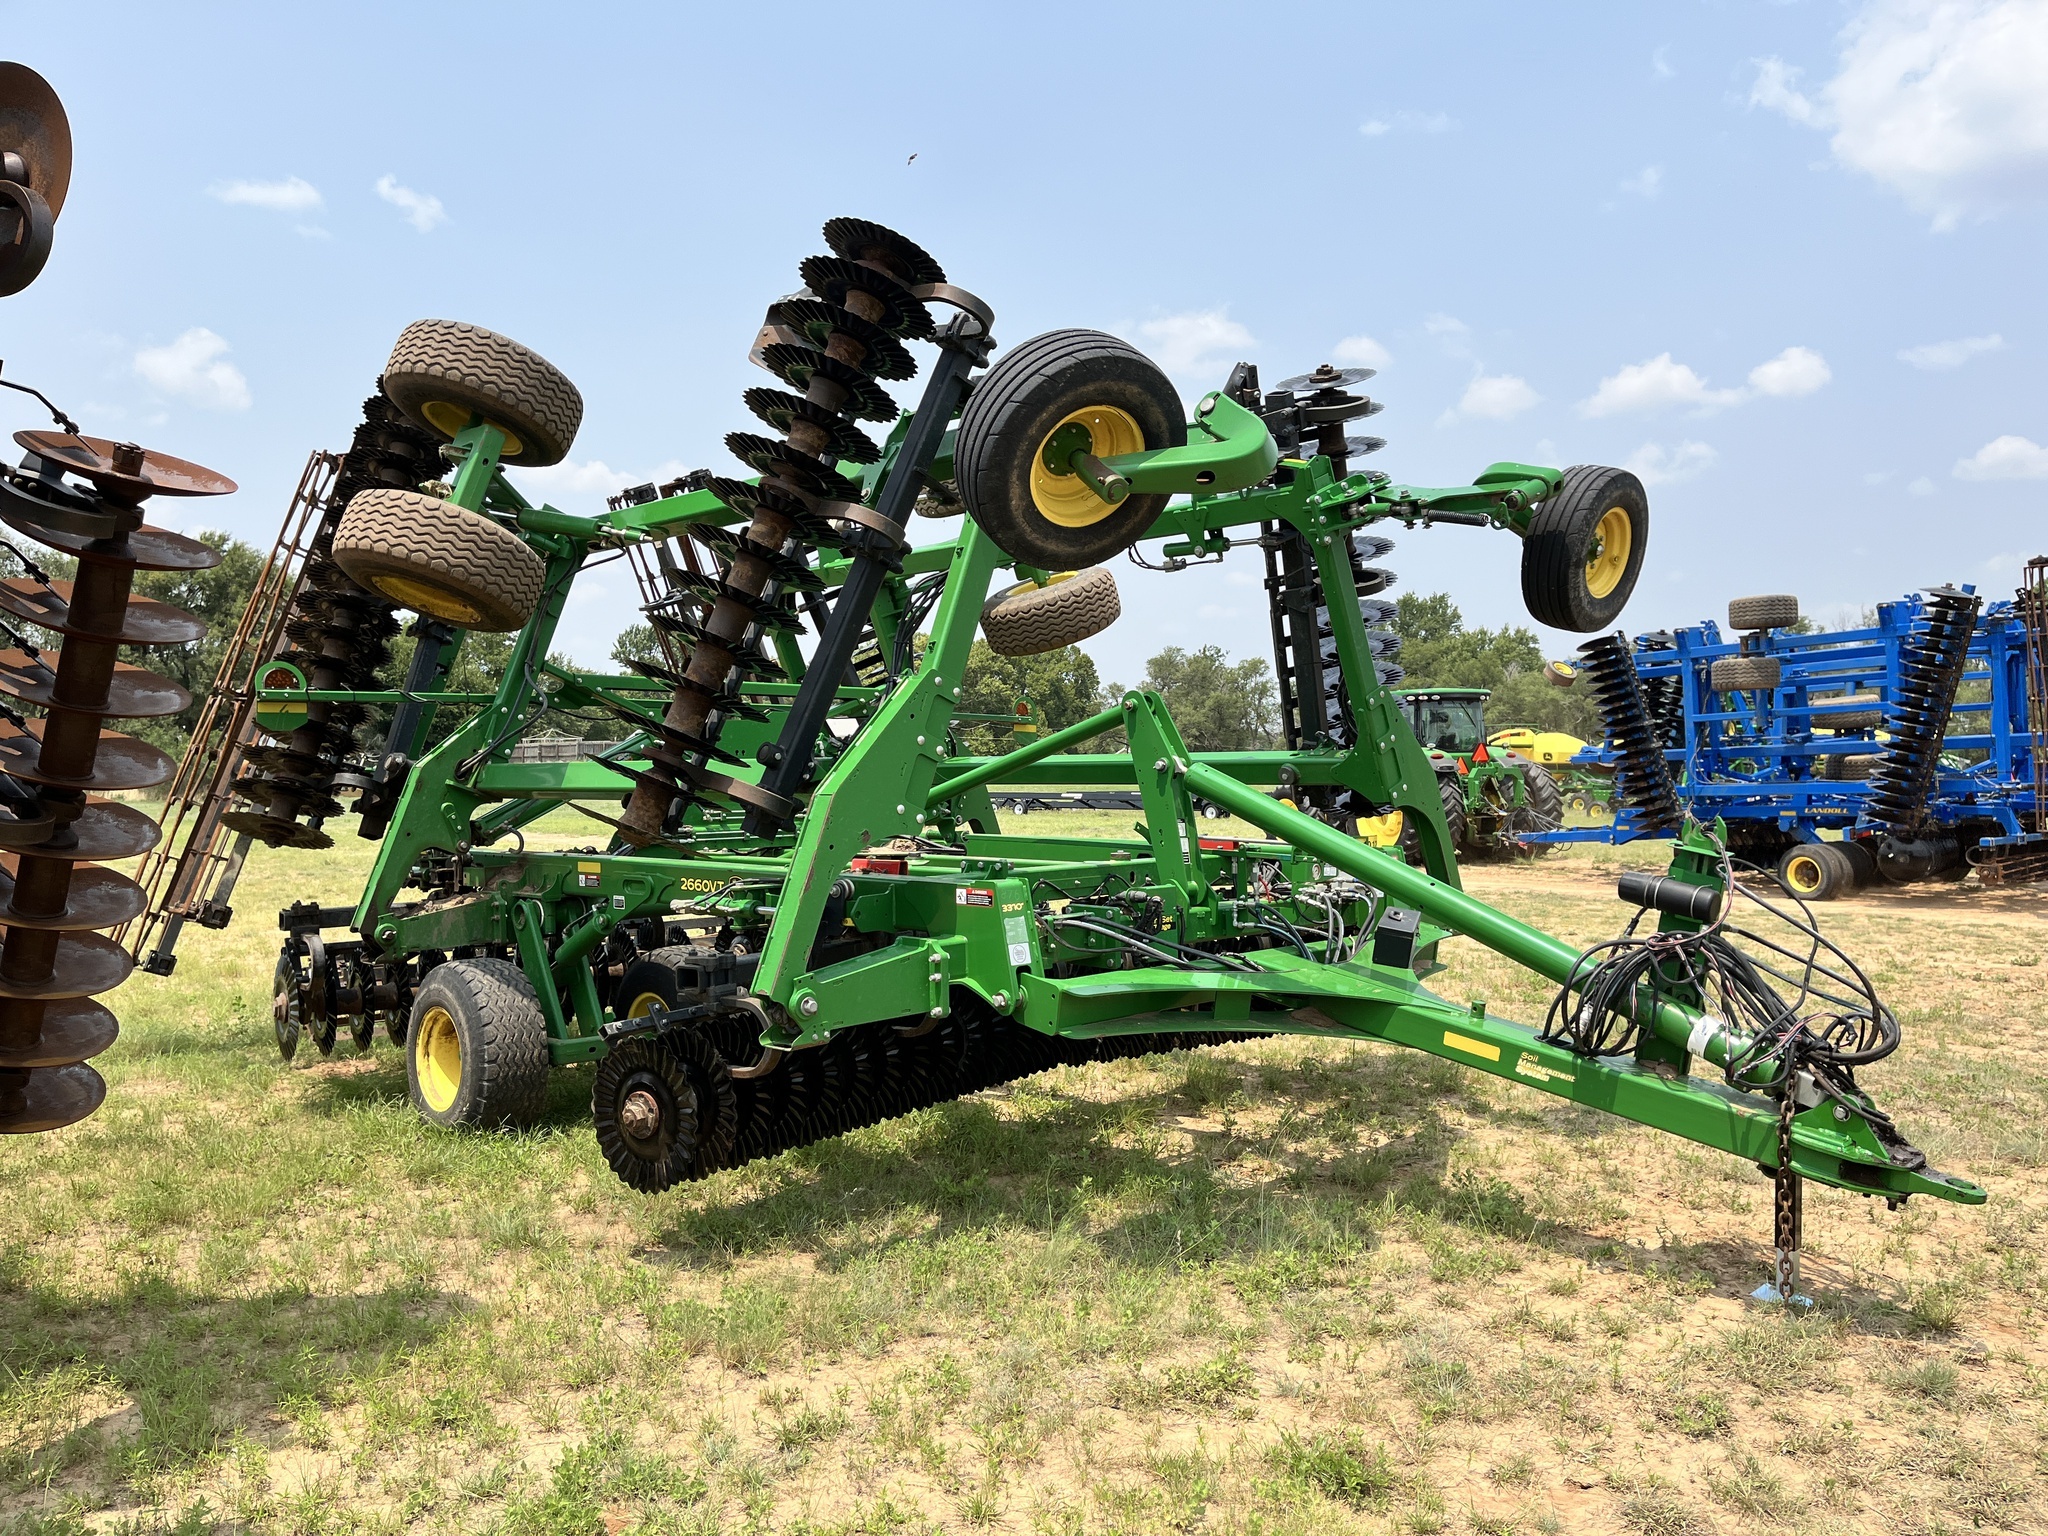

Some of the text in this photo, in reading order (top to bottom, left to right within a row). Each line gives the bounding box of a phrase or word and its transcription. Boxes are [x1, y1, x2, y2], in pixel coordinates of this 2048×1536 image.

[680, 877, 725, 893] 2660VT
[1520, 1051, 1539, 1063] Soil
[1515, 1066, 1550, 1082] System
[1517, 1057, 1576, 1083] Management
